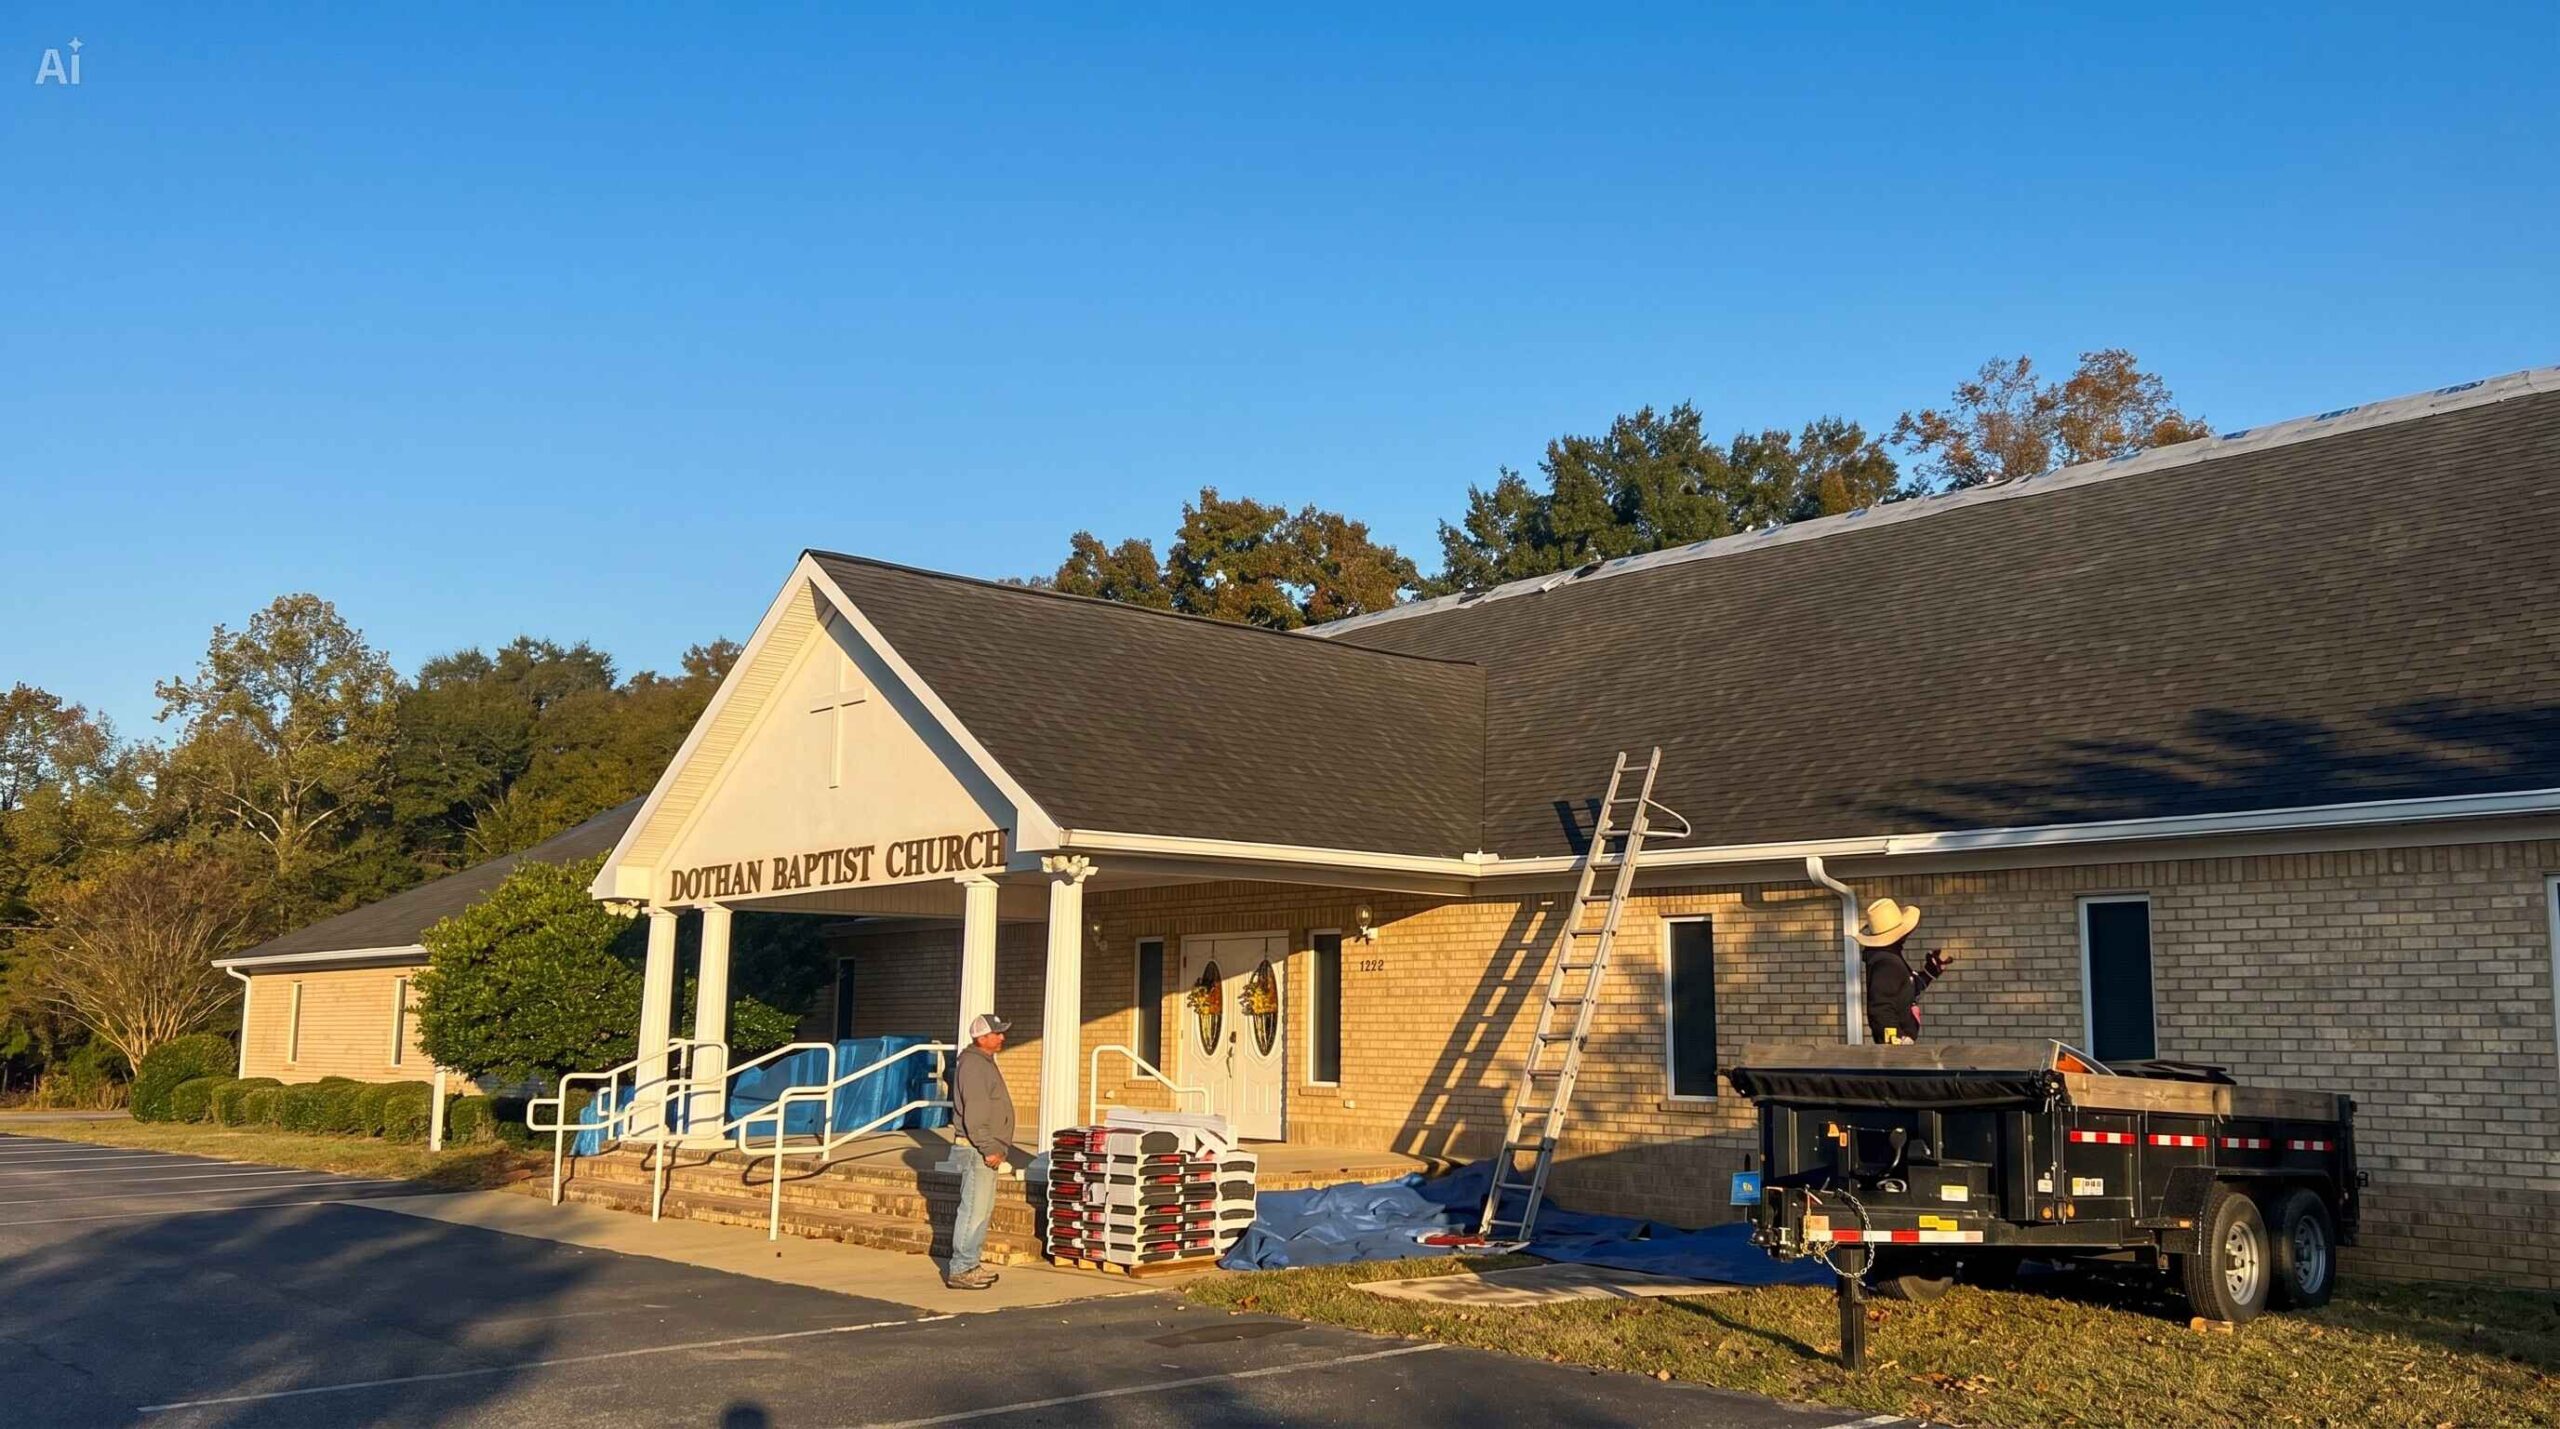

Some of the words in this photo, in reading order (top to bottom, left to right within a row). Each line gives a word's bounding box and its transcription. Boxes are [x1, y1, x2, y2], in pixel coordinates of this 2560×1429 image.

[669, 859, 764, 902] DOTHAN
[771, 845, 875, 891] BAPTIST
[885, 828, 1010, 878] CHURCH
[1360, 959, 1384, 972] 1222
